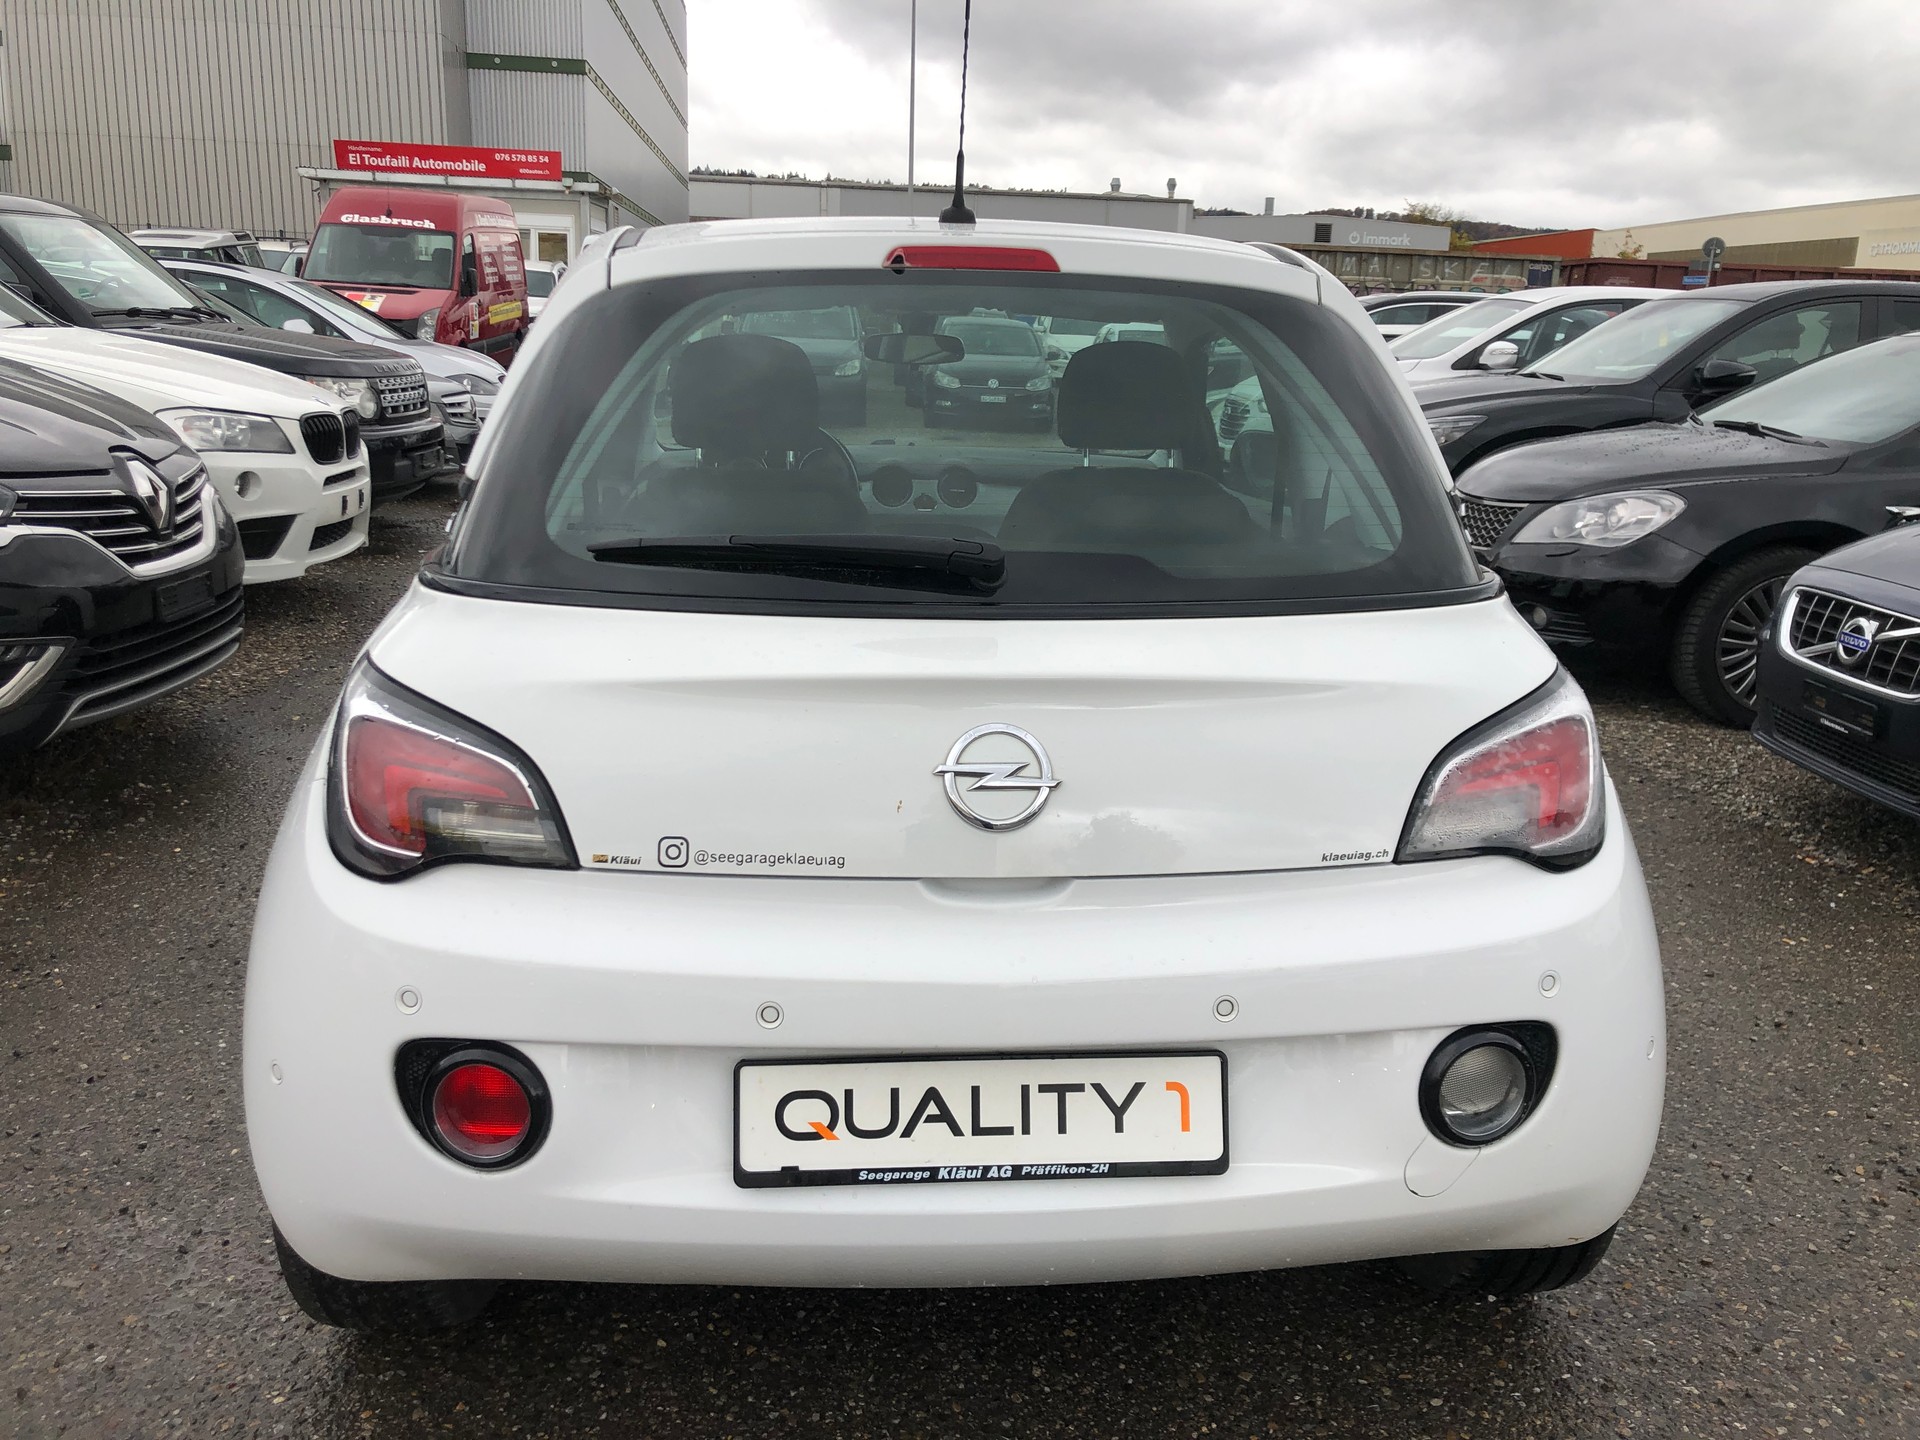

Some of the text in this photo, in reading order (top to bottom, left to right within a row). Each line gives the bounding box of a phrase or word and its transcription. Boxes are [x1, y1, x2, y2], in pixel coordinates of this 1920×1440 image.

[348, 153, 487, 173] El Toufaili Automobile
[494, 152, 549, 164] 076 578 85 54
[340, 213, 436, 230] Glasbruch
[1528, 263, 1553, 273] cargo
[1840, 634, 1867, 648] VOLVO
[610, 855, 642, 865] Kläui
[1321, 848, 1389, 862] klaeuiag.ch
[774, 1081, 1146, 1142] QUALITY
[858, 1163, 1110, 1181] Seegarage Kläui AG Pfäffikon-ZH
